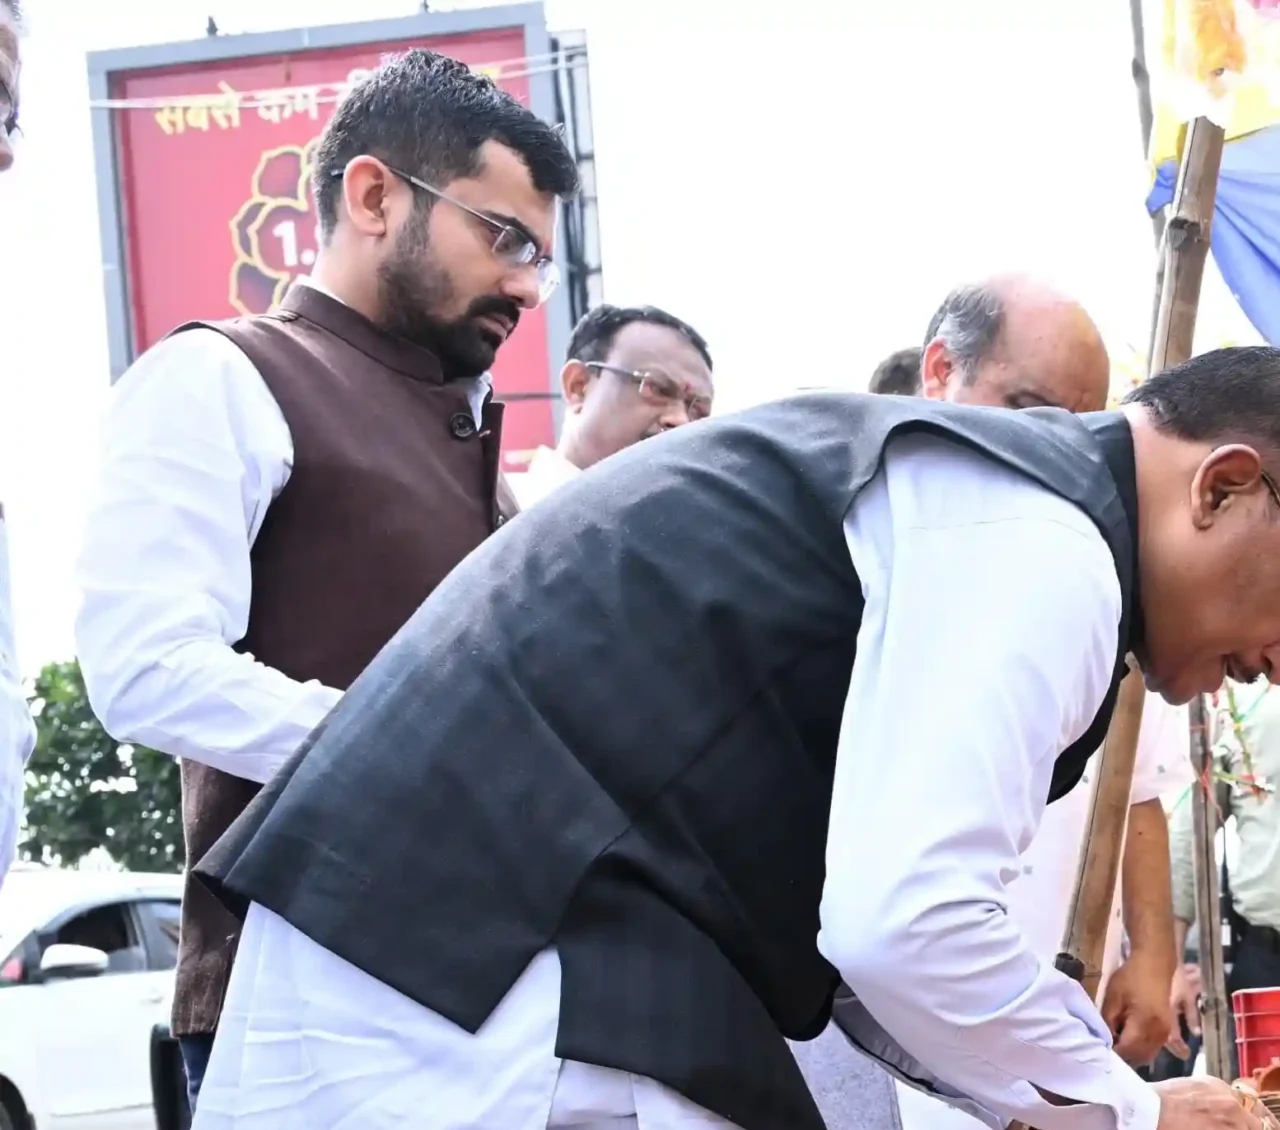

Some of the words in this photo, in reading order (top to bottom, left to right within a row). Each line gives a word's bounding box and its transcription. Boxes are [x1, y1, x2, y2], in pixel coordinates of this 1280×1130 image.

[154, 80, 240, 135] सबसे
[256, 87, 318, 124] कम
[272, 220, 320, 267] 1.
